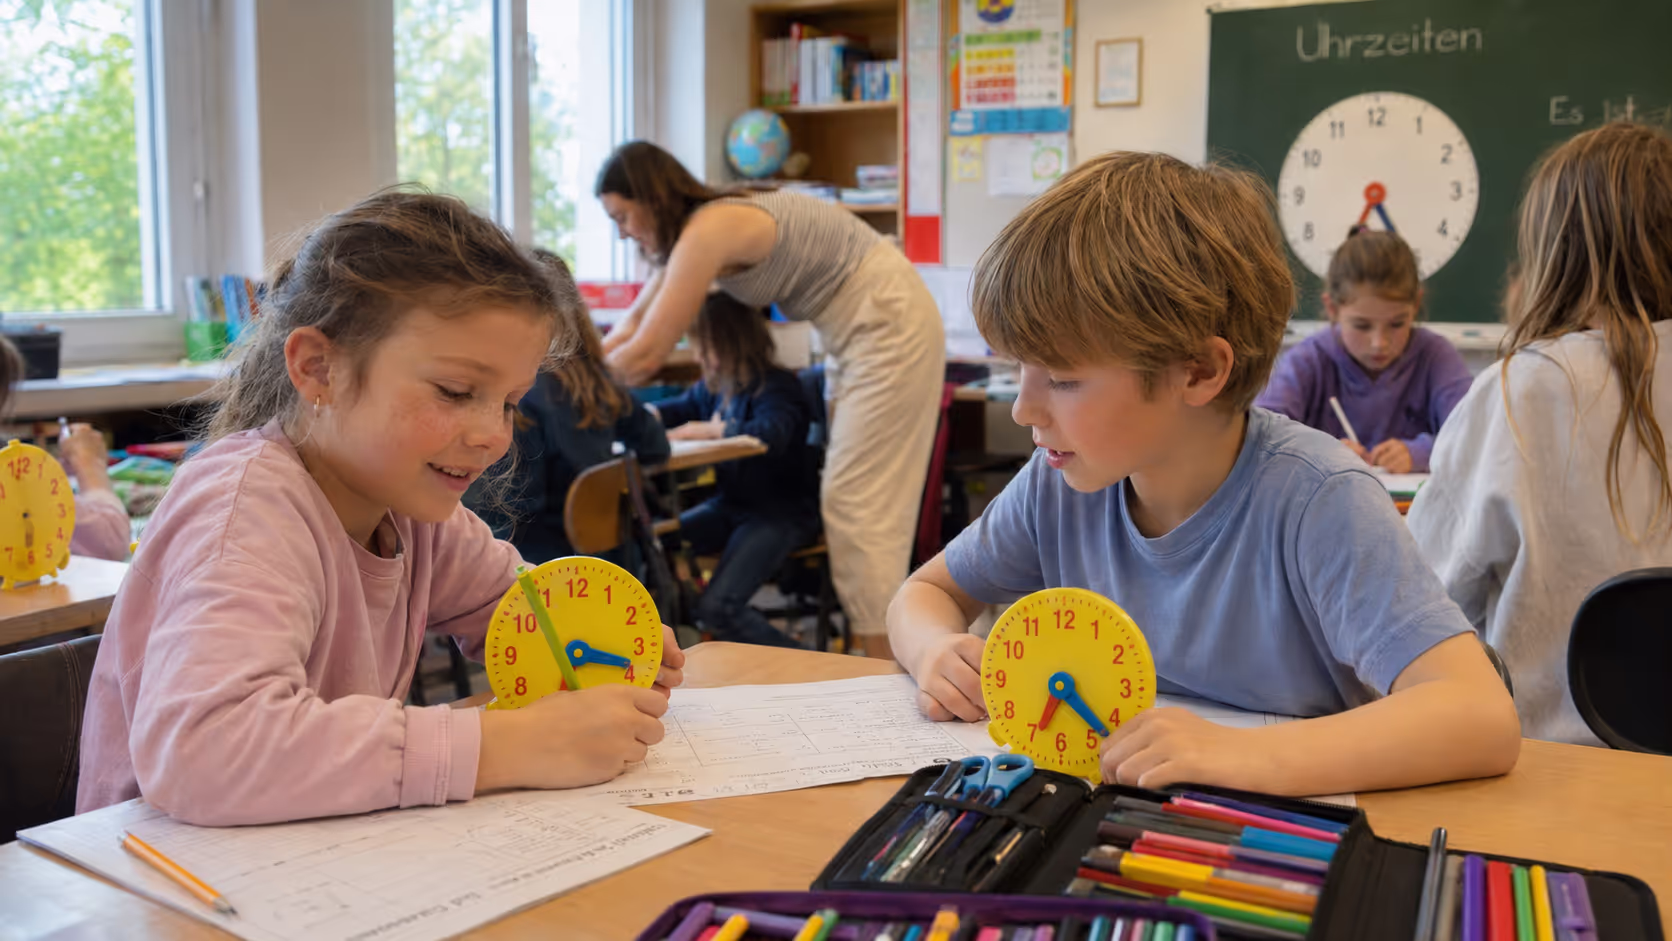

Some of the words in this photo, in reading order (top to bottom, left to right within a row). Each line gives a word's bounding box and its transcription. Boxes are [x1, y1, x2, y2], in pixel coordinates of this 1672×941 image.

[1296, 17, 1482, 62] Uhrzeiten
[1368, 107, 1386, 127] 12
[1550, 95, 1584, 125] Es
[1330, 121, 1345, 139] 11
[1415, 116, 1422, 135] 1
[1303, 149, 1322, 168] 10
[1440, 143, 1452, 164] 2
[1294, 186, 1305, 206] 9
[1450, 181, 1462, 201] 3
[1304, 222, 1314, 241] 8
[1437, 218, 1448, 239] 4
[50, 478, 59, 496] 2
[57, 503, 67, 519] 3
[56, 527, 64, 540] 4
[4, 546, 13, 562] 7
[27, 550, 35, 565] 6
[45, 543, 53, 559] 5
[566, 578, 589, 598] 12
[604, 585, 611, 604] 1
[513, 613, 537, 633] 10
[625, 606, 637, 626] 2
[1053, 609, 1075, 630] 12
[1023, 616, 1039, 636] 11
[1091, 620, 1099, 640] 1
[505, 646, 517, 665] 9
[633, 637, 644, 656] 3
[1003, 640, 1024, 660] 10
[1112, 644, 1124, 664] 2
[624, 665, 635, 683] 4
[995, 669, 1006, 688] 9
[515, 677, 527, 696] 8
[1120, 678, 1132, 698] 3
[1004, 700, 1015, 719] 8
[1109, 708, 1120, 727] 4
[1027, 723, 1038, 742] 7
[1055, 732, 1067, 752] 6
[1086, 729, 1097, 749] 5
